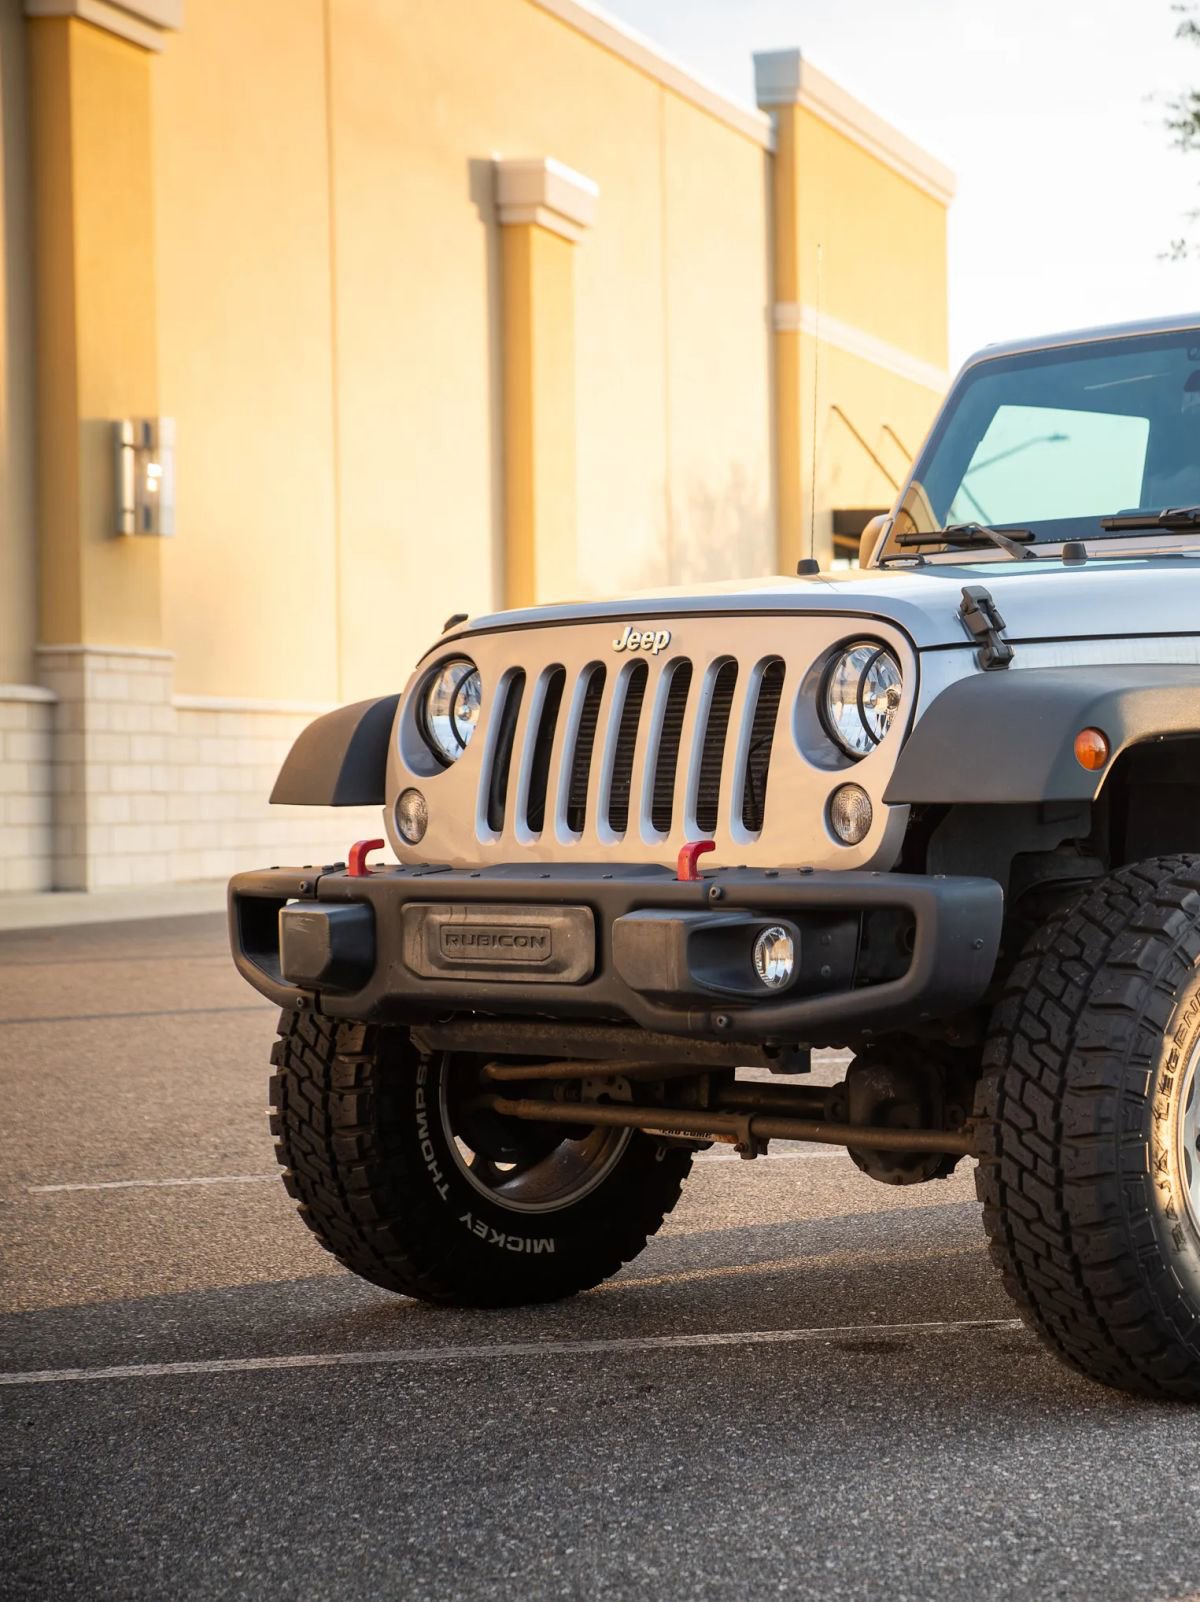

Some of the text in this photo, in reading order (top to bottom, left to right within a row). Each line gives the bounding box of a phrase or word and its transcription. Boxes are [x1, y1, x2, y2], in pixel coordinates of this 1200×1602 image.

[612, 626, 671, 655] Jeep
[445, 933, 546, 949] RUBICON
[459, 1212, 556, 1254] MICKEY
